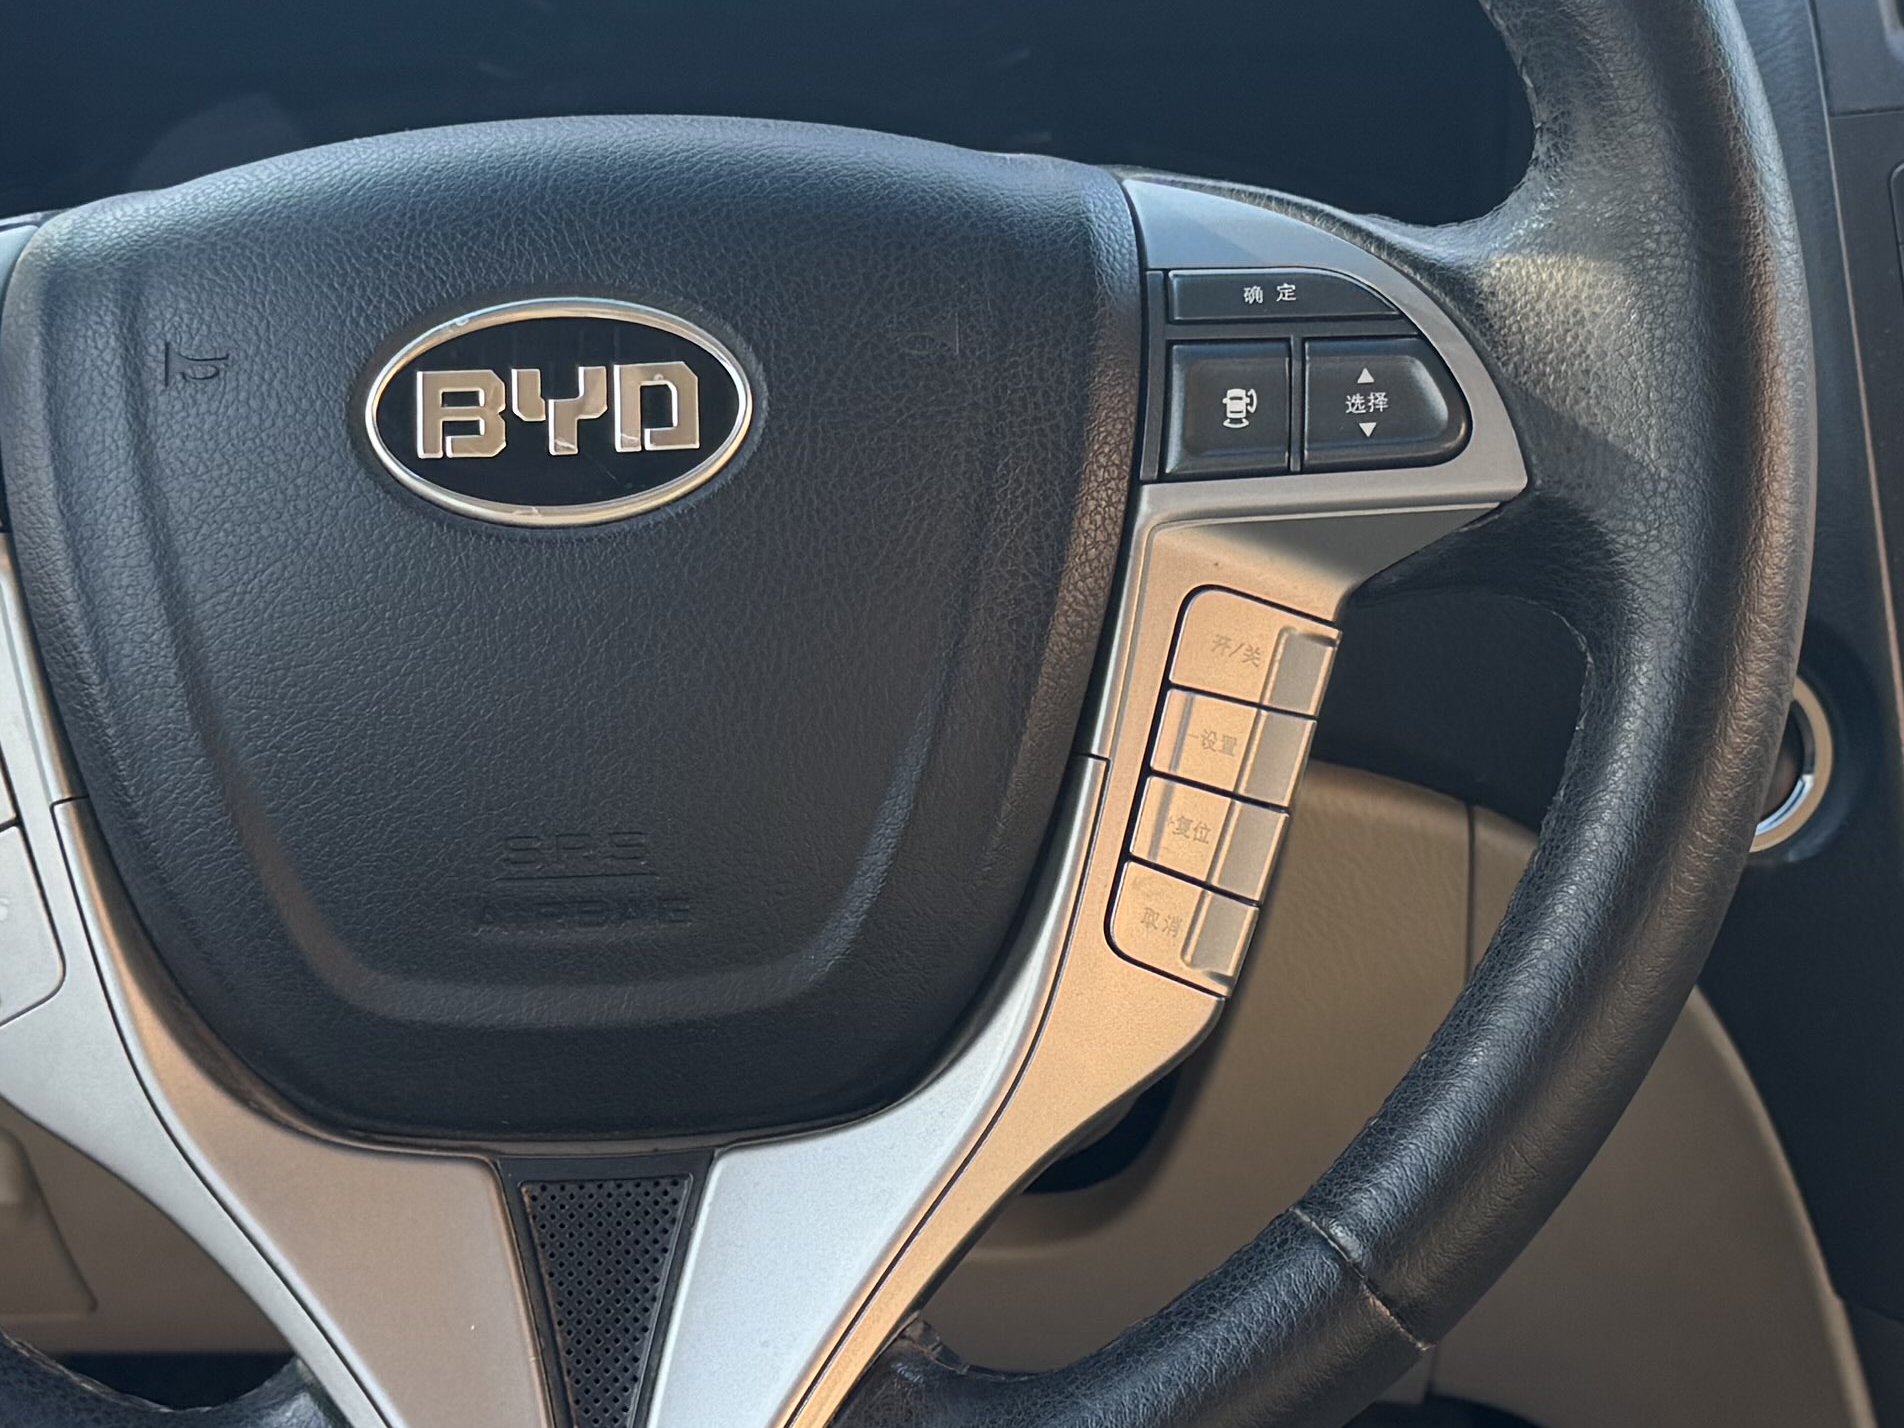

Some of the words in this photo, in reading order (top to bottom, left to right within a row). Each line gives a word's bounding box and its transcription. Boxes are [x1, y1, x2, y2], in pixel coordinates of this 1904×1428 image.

[1243, 282, 1297, 304] 确定
[415, 360, 701, 460] BYD
[1345, 391, 1389, 414] 选择
